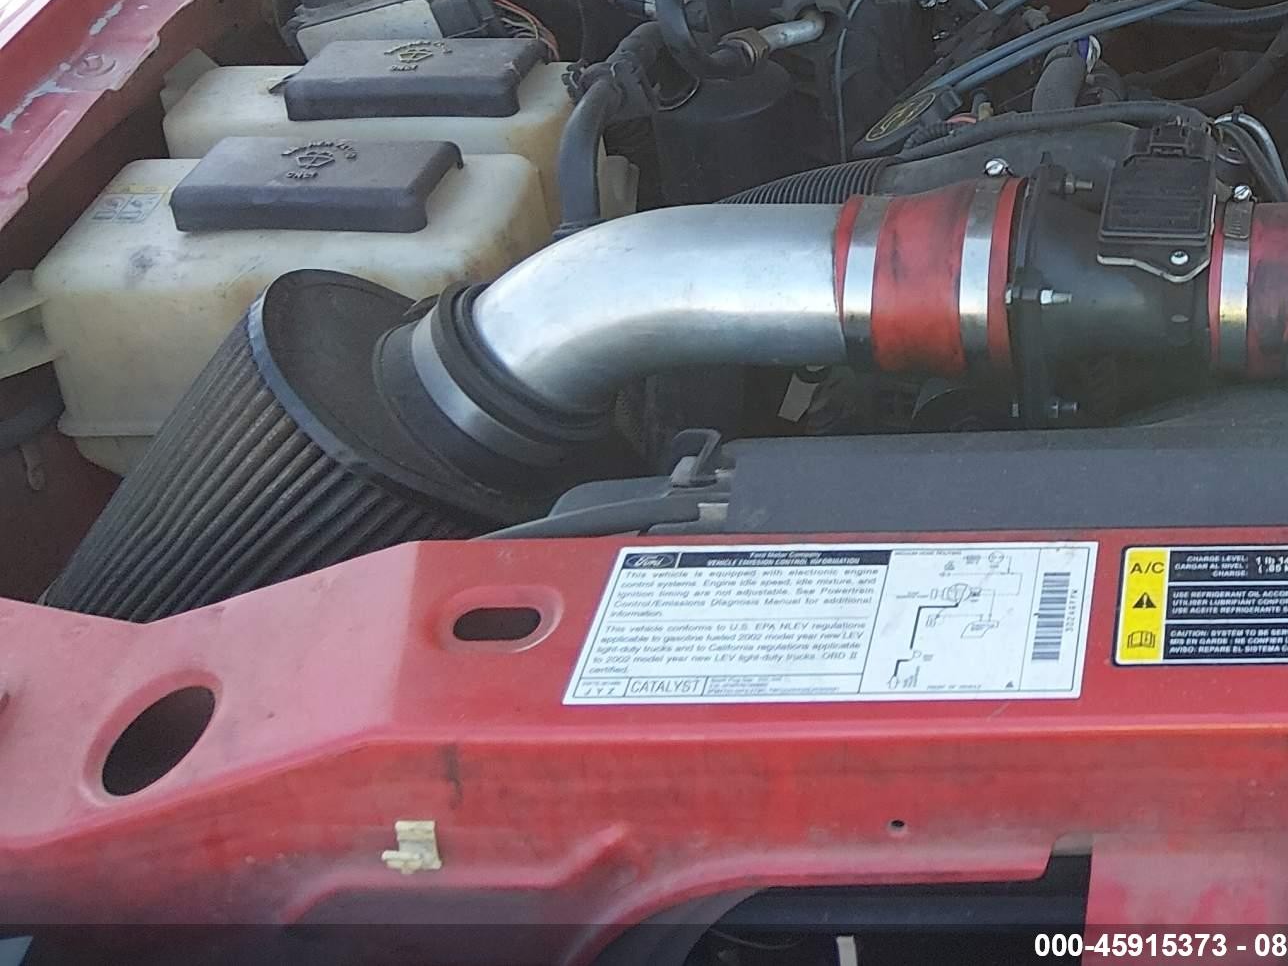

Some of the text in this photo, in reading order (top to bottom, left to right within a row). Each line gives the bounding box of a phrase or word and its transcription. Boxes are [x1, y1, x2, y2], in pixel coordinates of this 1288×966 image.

[633, 554, 665, 567] Ford
[706, 557, 860, 567] VEHICLE EMISSION CONTROL INFORMATION
[1186, 555, 1220, 563] CHARGE
[1256, 556, 1261, 565] 1
[1130, 561, 1165, 575] A/C
[1222, 562, 1244, 570] NIVEL
[626, 570, 646, 578] This
[694, 569, 703, 577] is
[708, 569, 756, 579] equipped
[762, 568, 783, 576] with
[788, 568, 838, 576] electronic
[844, 567, 878, 578] engine
[620, 577, 877, 589] control Engine idle idle and
[616, 589, 654, 600] ignition
[659, 589, 690, 599] timing
[715, 588, 732, 596] not
[820, 587, 874, 595] Powertrain
[710, 599, 759, 608] Diagnosis
[805, 597, 819, 605] for
[824, 596, 872, 604] additional
[1209, 598, 1256, 606] LUBRIFIANT
[606, 625, 625, 633] This
[667, 624, 712, 632] conforms
[812, 621, 866, 632] regulations
[1210, 629, 1244, 637] SYSTEM
[601, 636, 648, 645] applicable
[664, 635, 704, 644] gasoline
[737, 633, 762, 641] 2002
[842, 631, 864, 639] LEV
[1247, 636, 1284, 644] CONFIER
[595, 646, 640, 656] light-duty
[757, 643, 810, 652] regulations
[812, 641, 860, 651] applicable
[593, 656, 602, 664] to
[739, 654, 784, 663] light-duty
[630, 680, 700, 694] CATALYST
